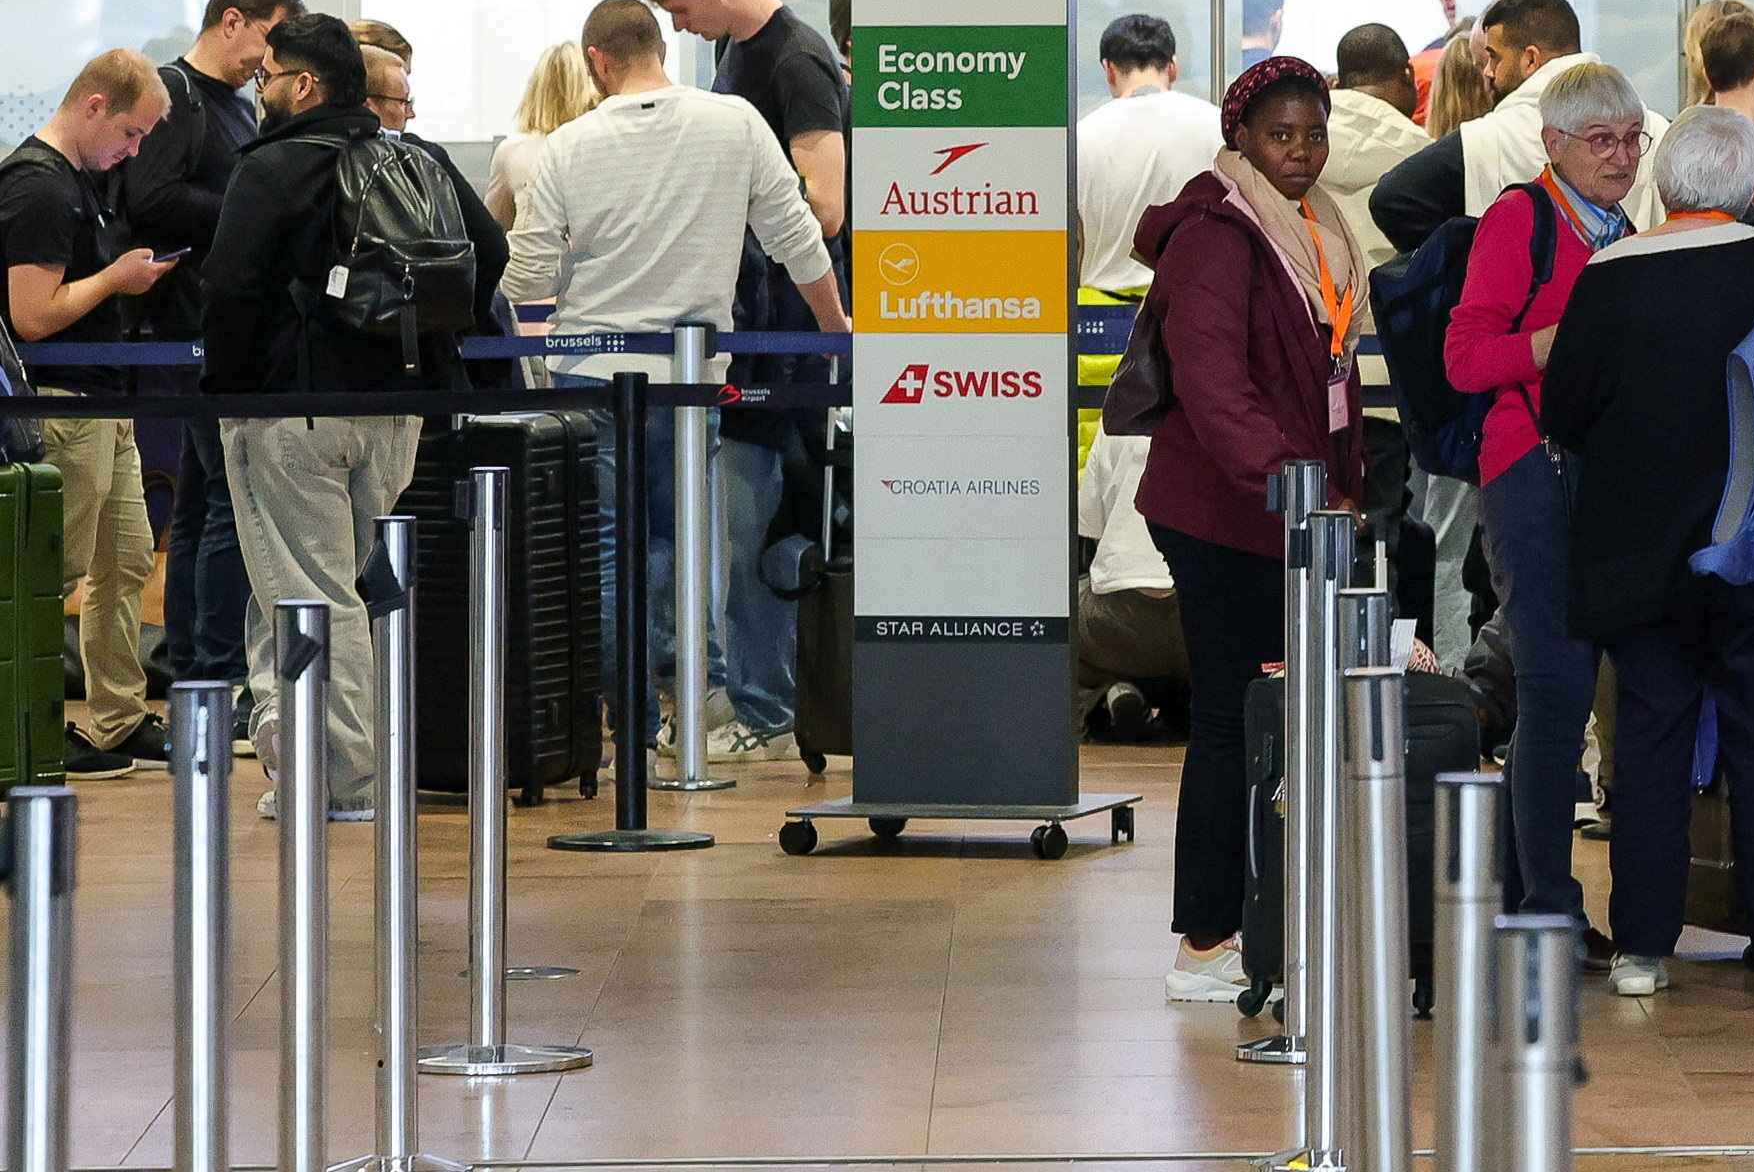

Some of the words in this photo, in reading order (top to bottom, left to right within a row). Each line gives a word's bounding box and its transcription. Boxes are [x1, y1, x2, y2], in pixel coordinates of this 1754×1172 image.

[878, 44, 1027, 80] Economy
[877, 80, 963, 111] Class
[880, 181, 1039, 215] Austrian
[880, 290, 1041, 319] Lufthansa
[545, 335, 602, 348] brussels
[933, 370, 1043, 398] SWISS
[890, 479, 962, 495] CROATIA
[966, 479, 1041, 495] AIRLINES
[876, 621, 923, 636] STAR
[929, 621, 1023, 637] ALLIANCE
